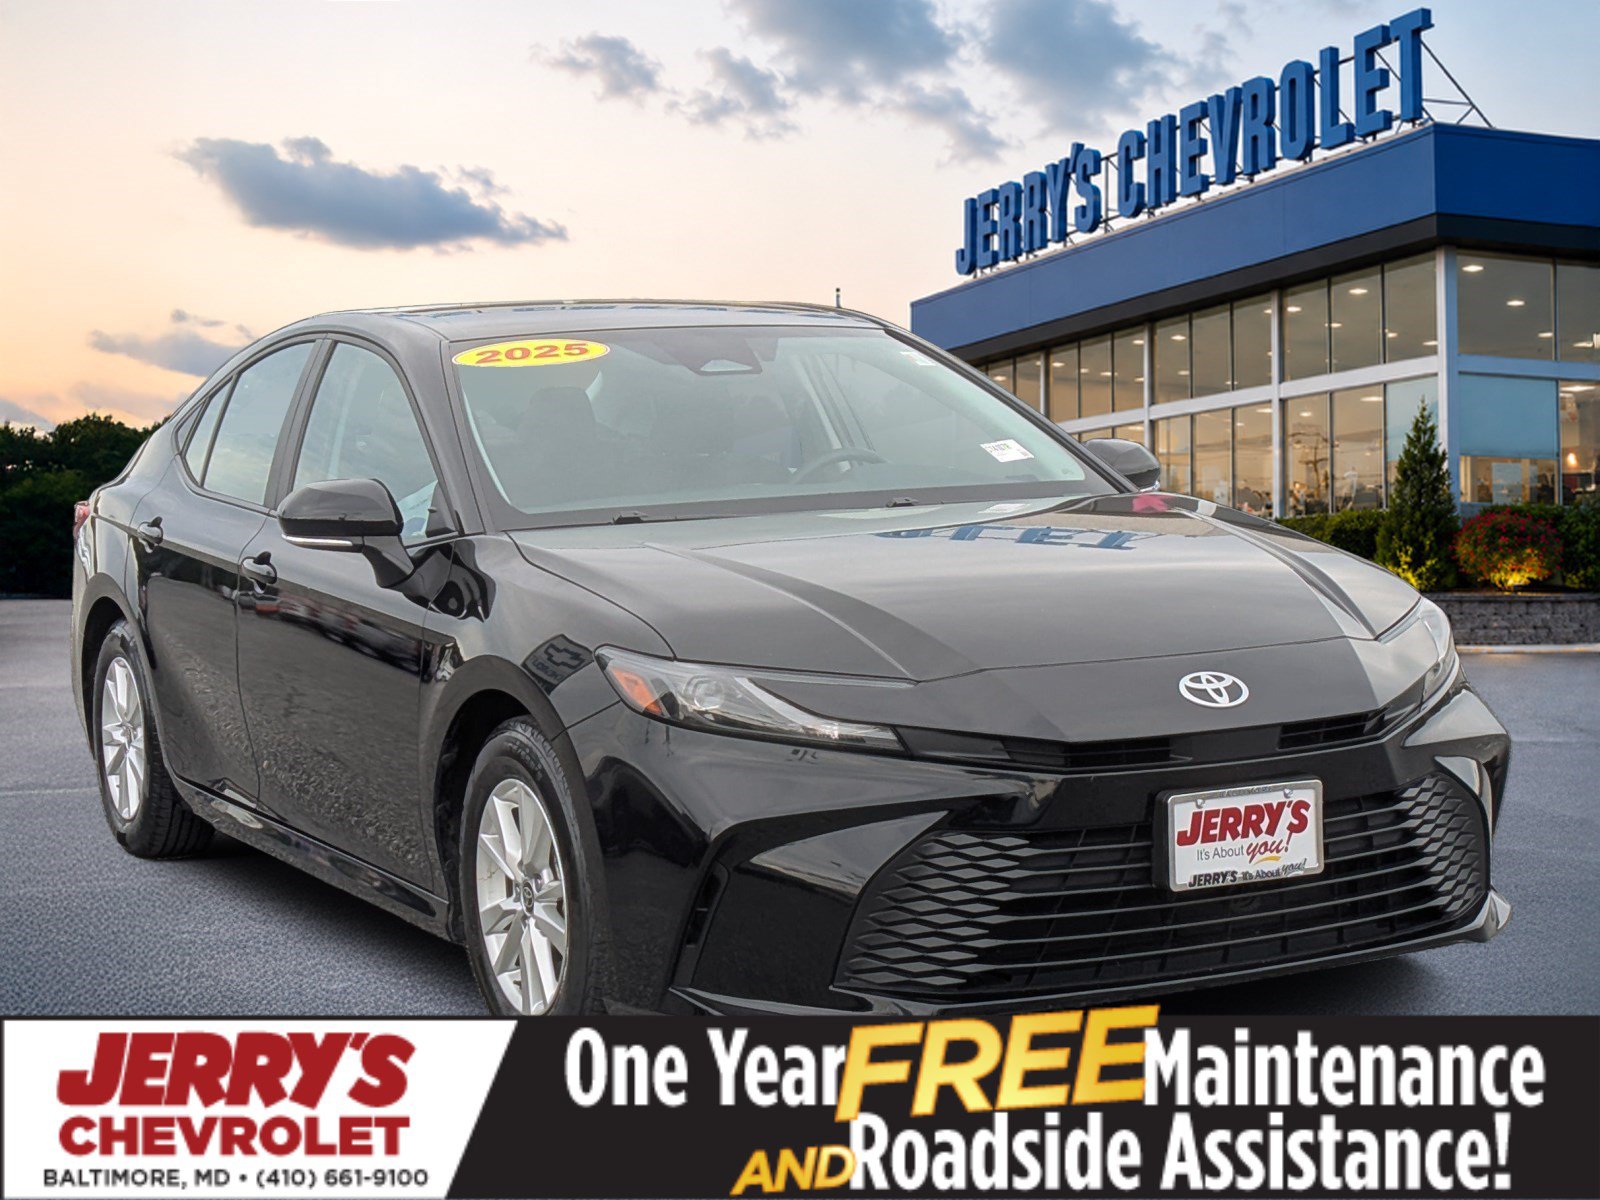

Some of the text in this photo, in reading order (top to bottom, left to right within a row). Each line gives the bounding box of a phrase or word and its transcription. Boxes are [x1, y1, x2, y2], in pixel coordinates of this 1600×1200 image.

[956, 8, 1434, 275] JERRY'S CHEVROLET
[474, 343, 590, 365] 2025
[1176, 799, 1311, 846] JERRY'S
[1196, 832, 1291, 864] It's About you!
[1188, 870, 1238, 887] JERRY'S
[1254, 868, 1280, 880] About
